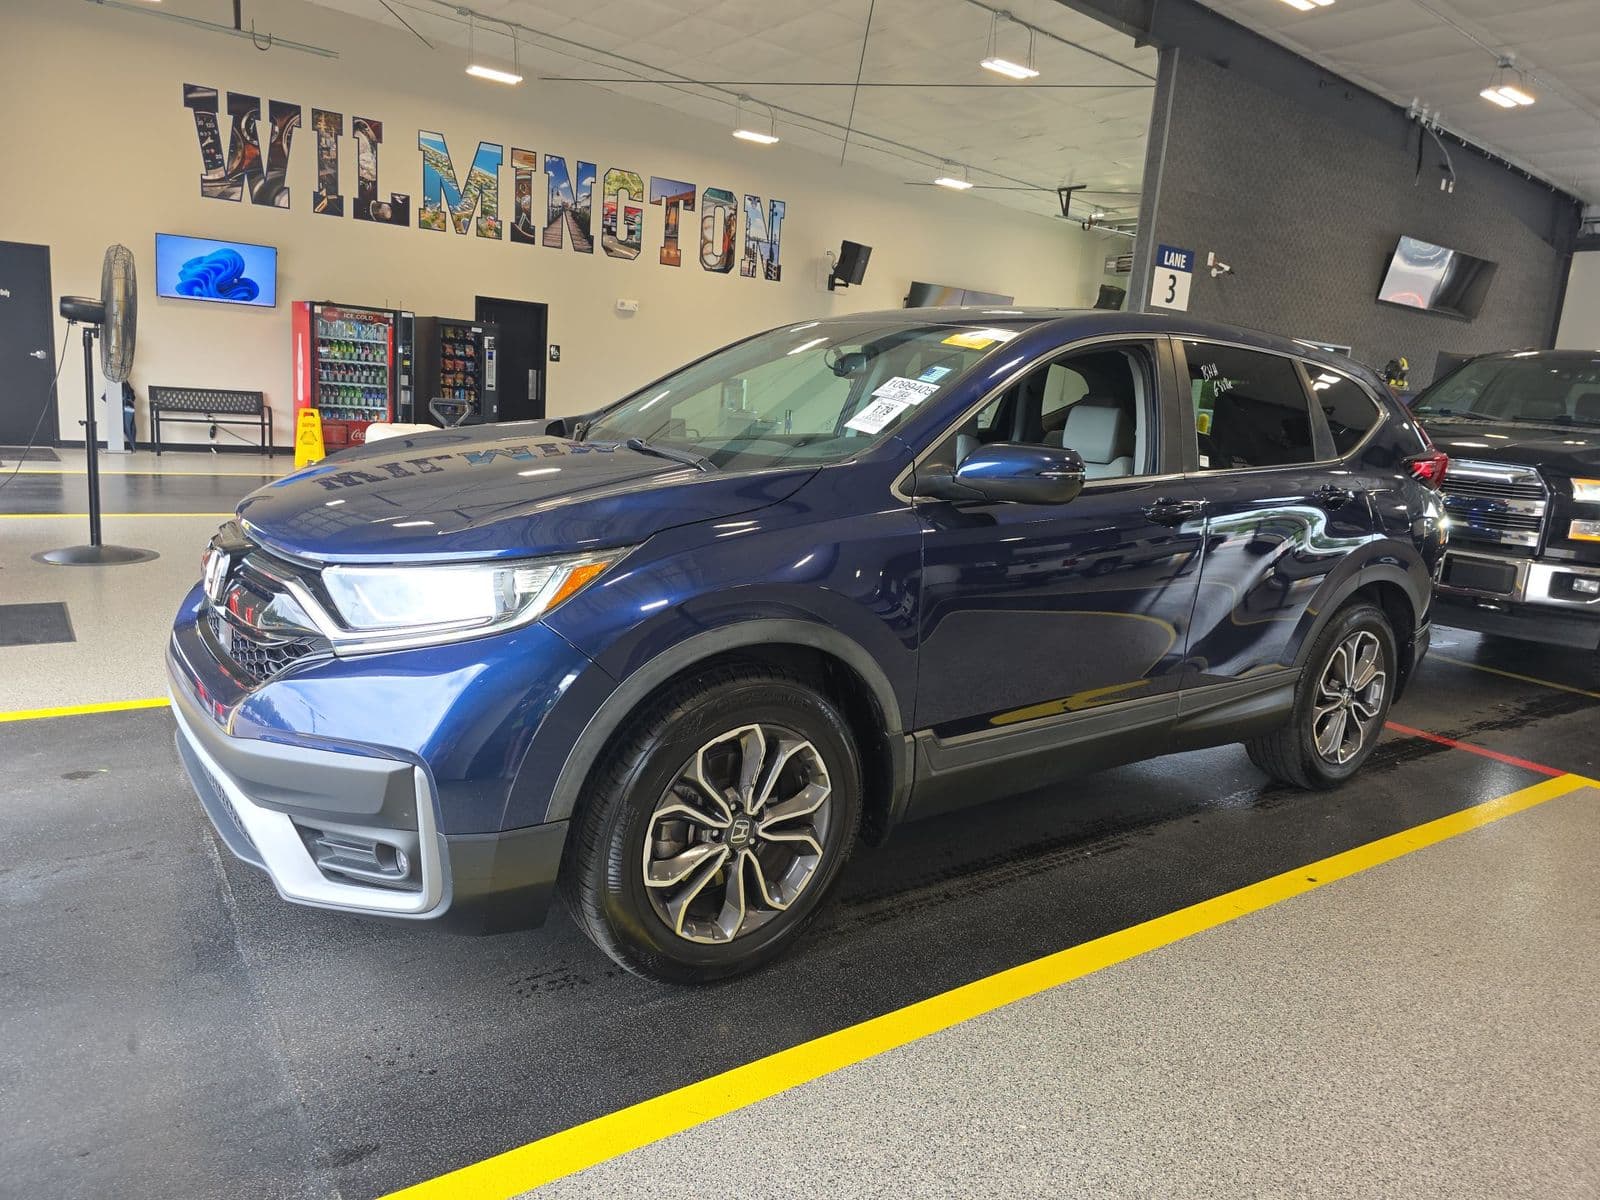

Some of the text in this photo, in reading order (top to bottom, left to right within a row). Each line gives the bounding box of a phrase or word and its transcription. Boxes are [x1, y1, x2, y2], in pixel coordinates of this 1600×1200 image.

[183, 83, 786, 282] WILMINGTON
[1163, 250, 1187, 269] LANE
[1165, 274, 1177, 304] 3
[355, 313, 374, 321] COLD
[888, 380, 937, 396] 1099405
